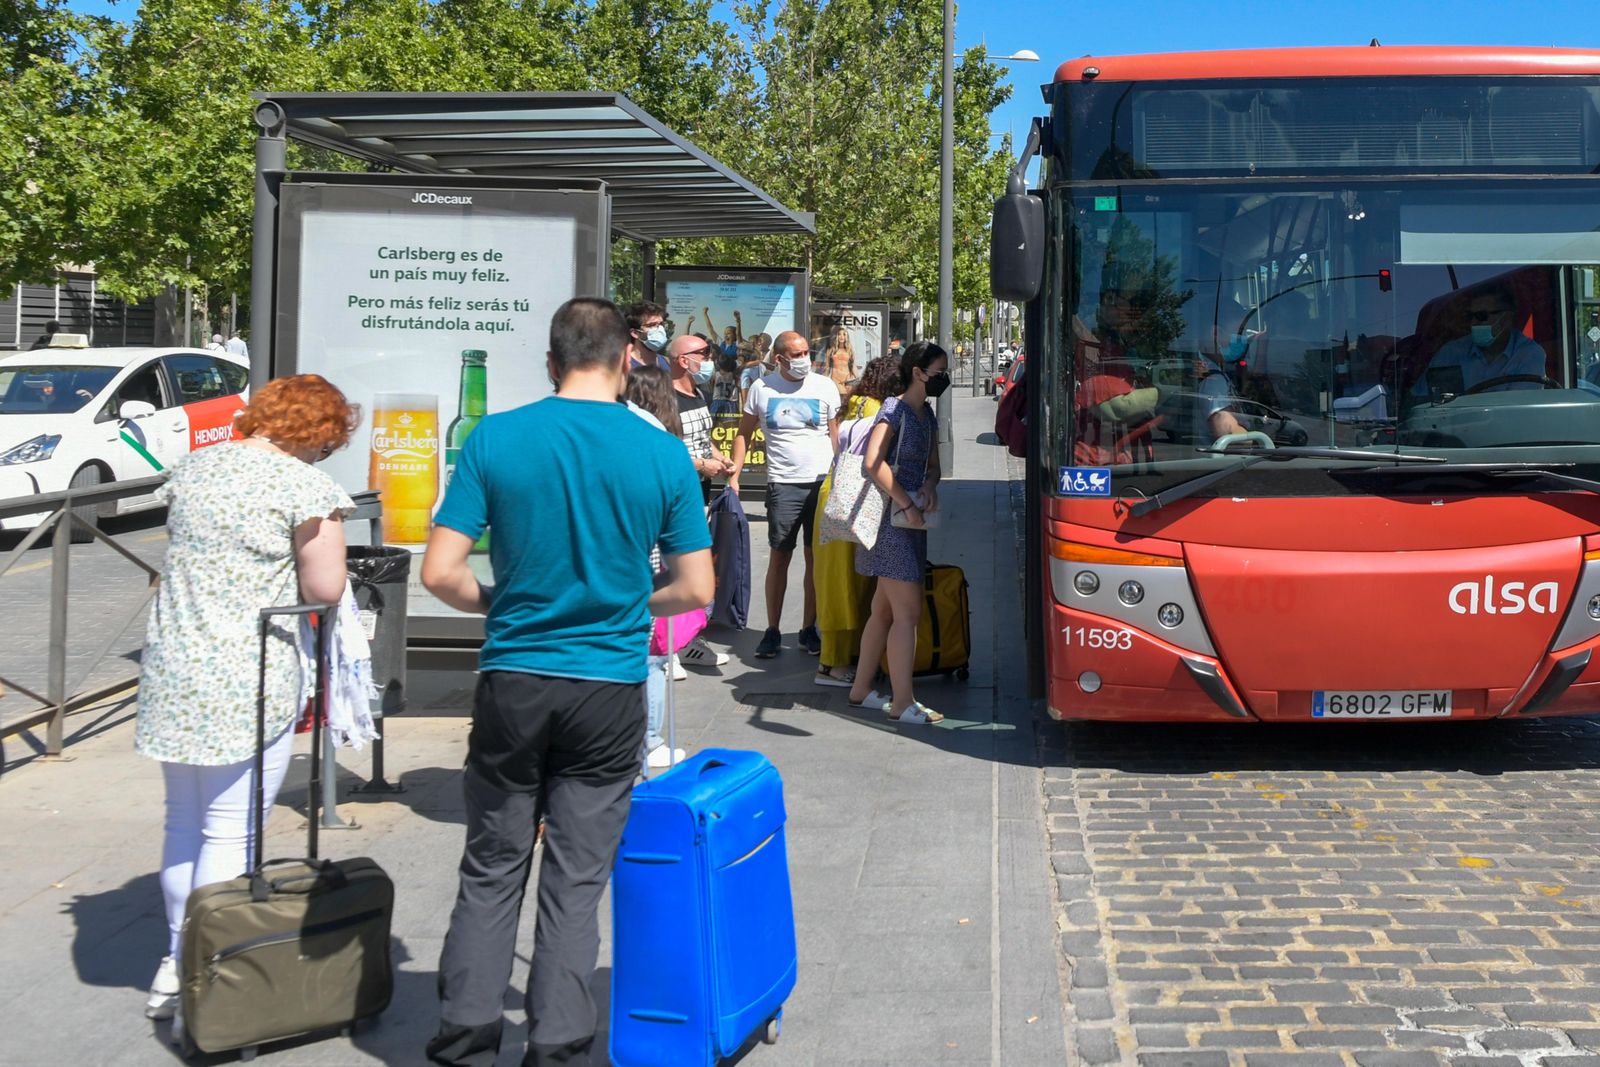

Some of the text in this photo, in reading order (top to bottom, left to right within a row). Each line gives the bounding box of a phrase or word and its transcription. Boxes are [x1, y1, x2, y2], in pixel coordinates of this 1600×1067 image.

[411, 193, 473, 205] JCDecaux
[377, 246, 503, 264] Carlsberg es de
[369, 267, 510, 284] un país muy feliz.
[348, 295, 529, 312] Pero más feliz serás tú
[361, 315, 515, 334] disfrutándola aquí.
[194, 422, 234, 445] HENDRIX
[372, 427, 438, 458] Carlsberg
[1448, 574, 1559, 615] alsa
[1061, 625, 1132, 650] 11593
[1329, 694, 1391, 715] 6802
[1401, 693, 1447, 714] GFM
